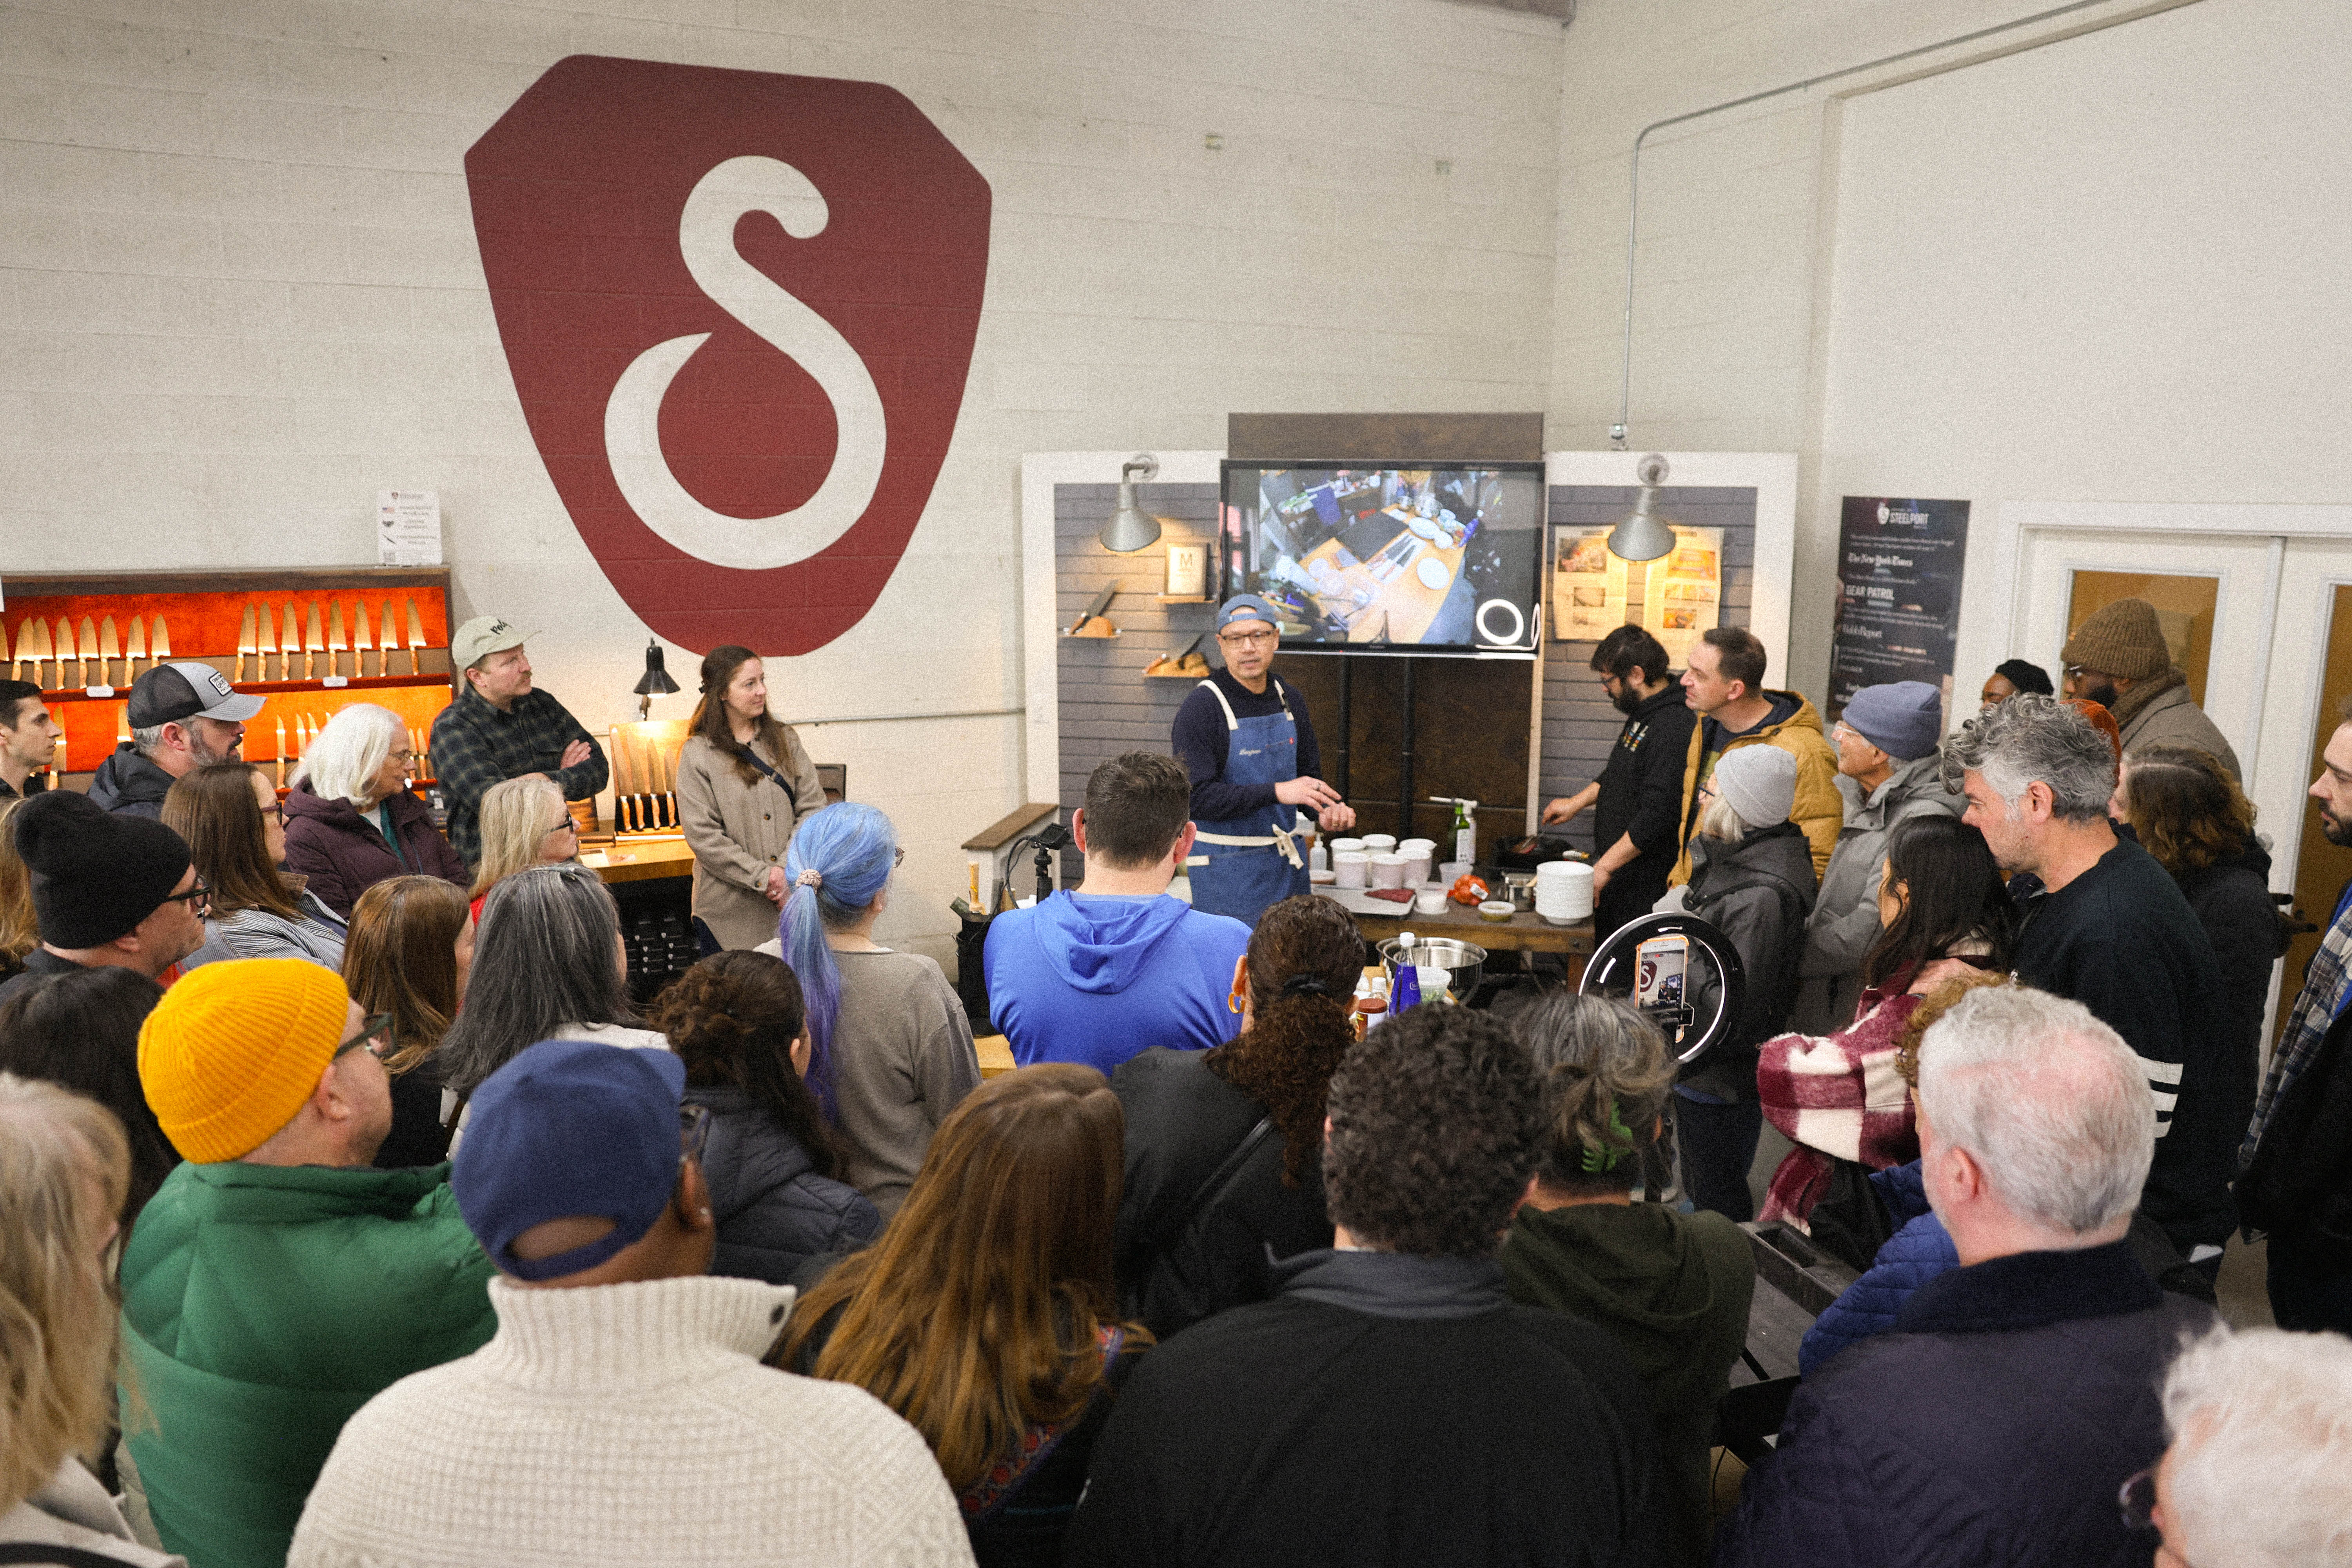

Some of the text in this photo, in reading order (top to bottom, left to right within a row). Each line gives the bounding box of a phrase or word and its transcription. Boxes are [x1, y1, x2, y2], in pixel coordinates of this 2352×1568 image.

[604, 155, 886, 570] S
[1846, 585, 1895, 600] GEAR PATROL
